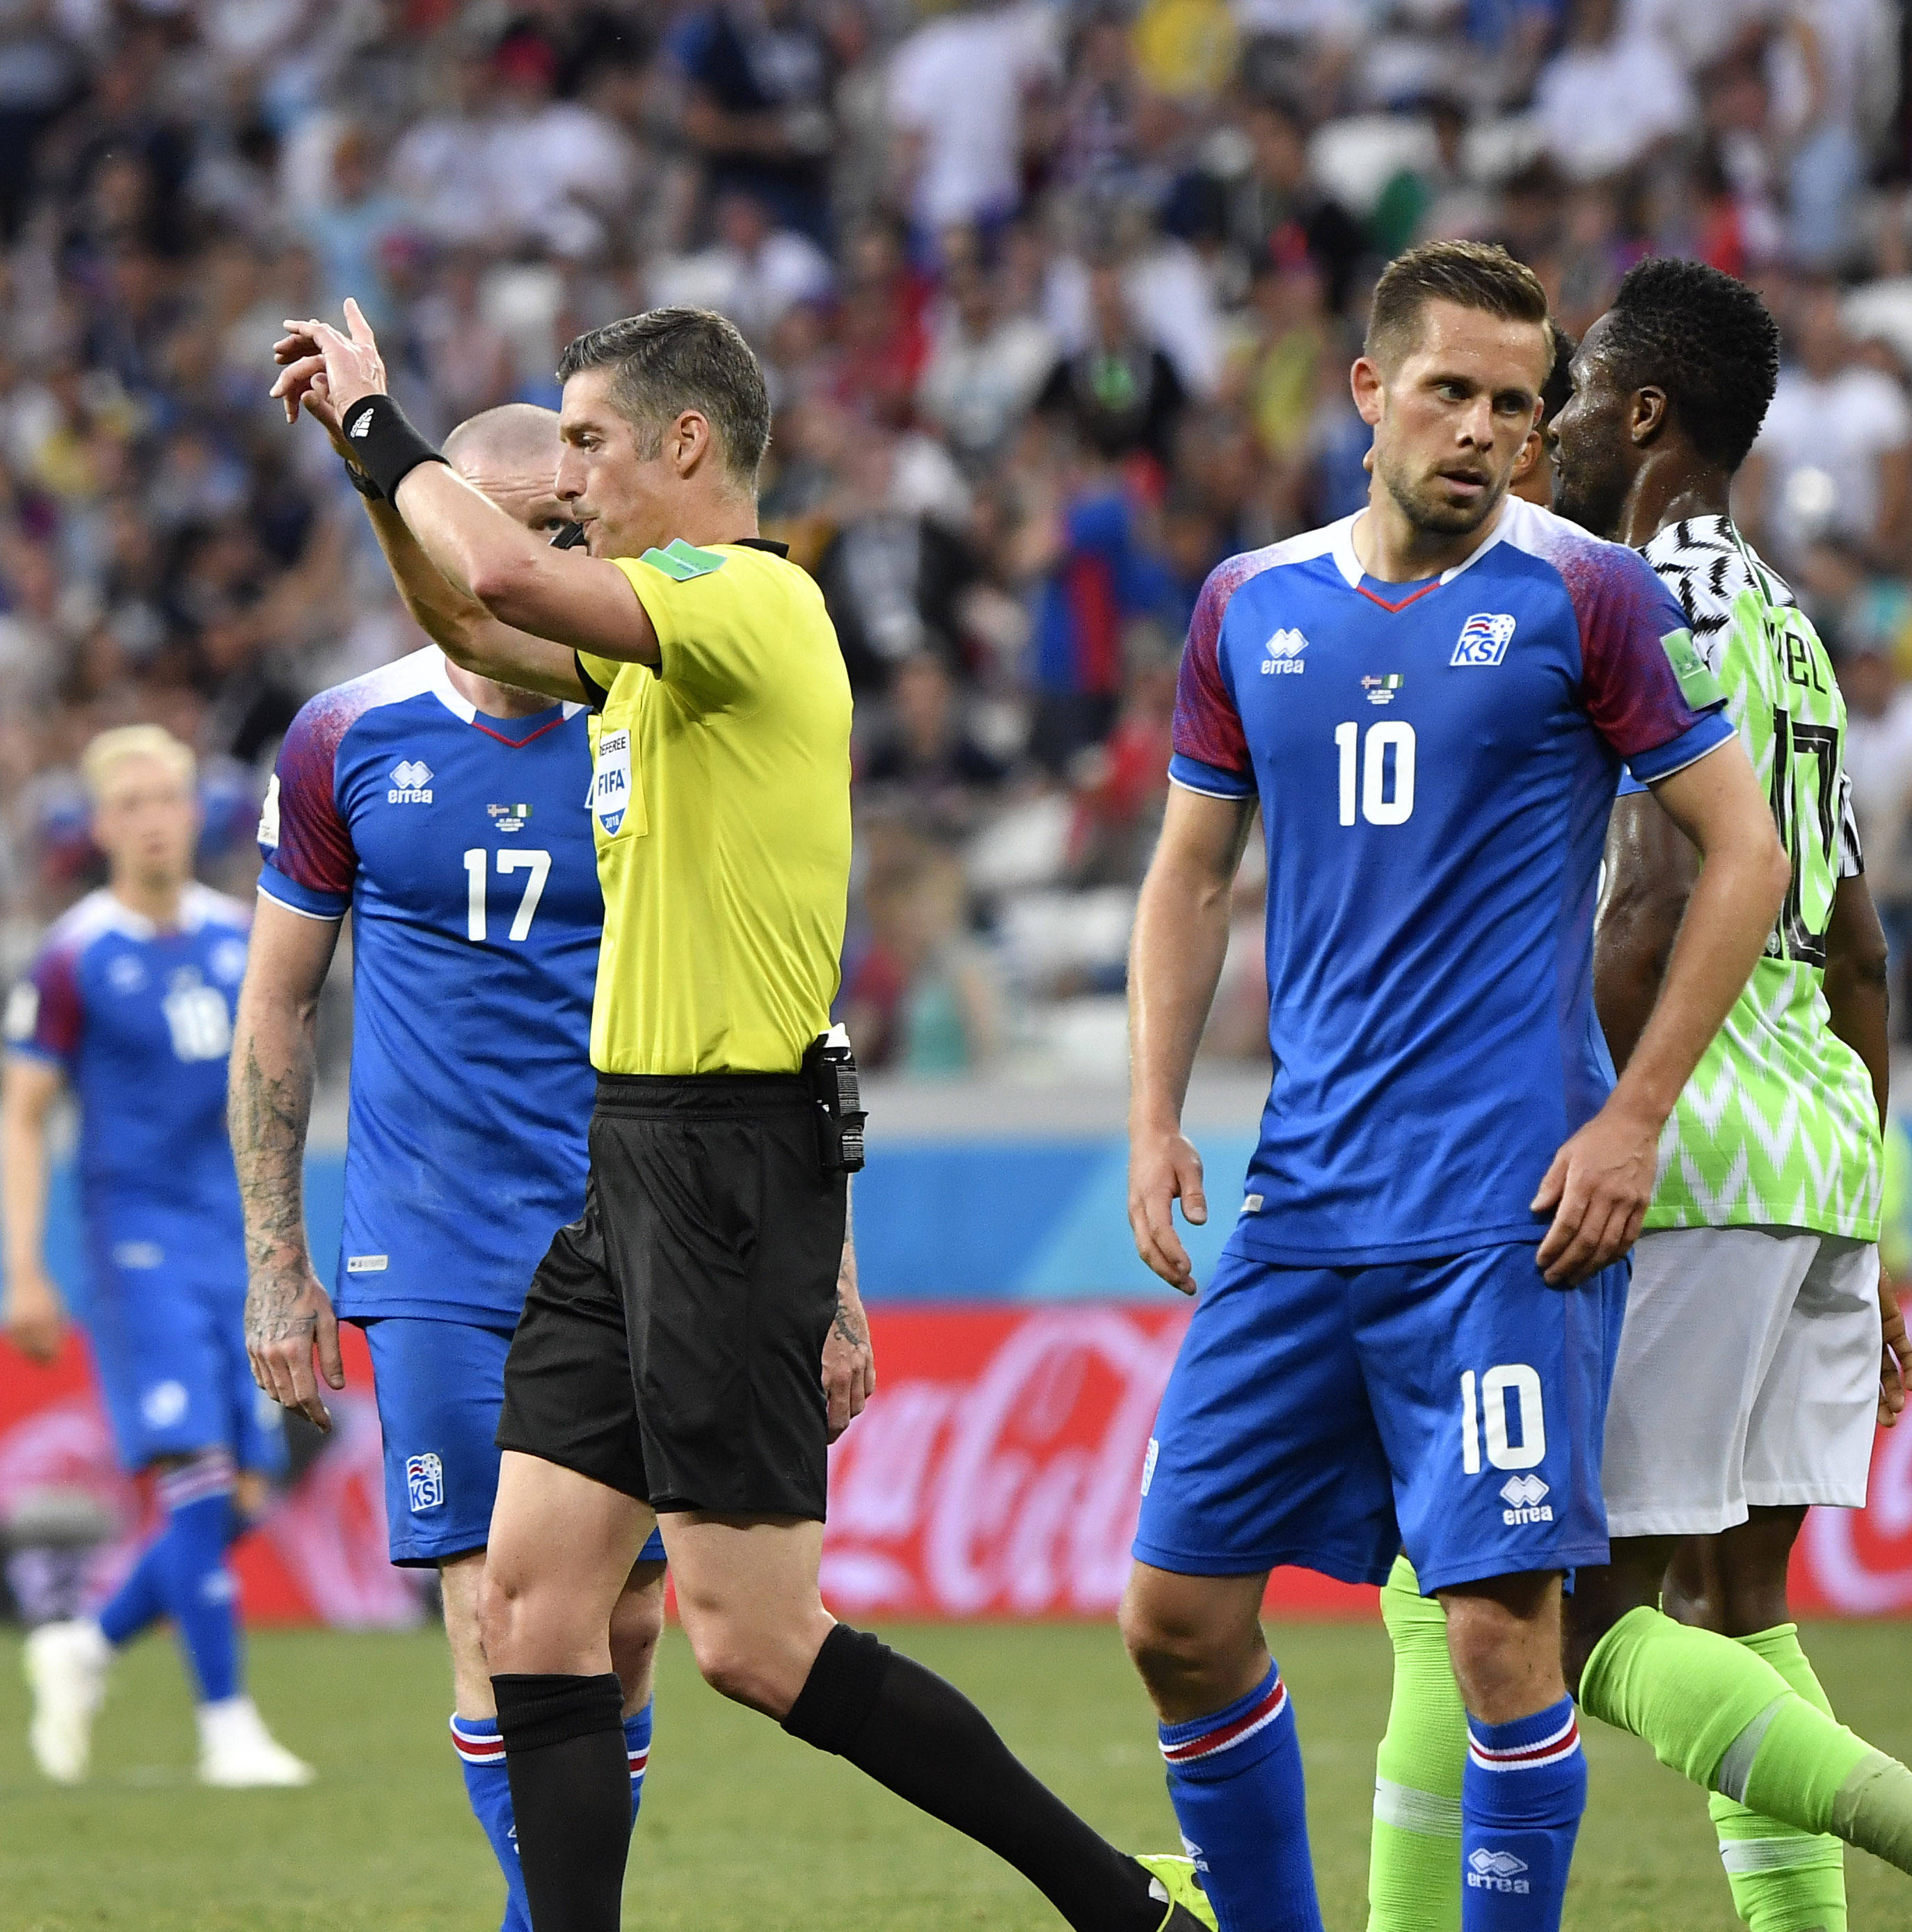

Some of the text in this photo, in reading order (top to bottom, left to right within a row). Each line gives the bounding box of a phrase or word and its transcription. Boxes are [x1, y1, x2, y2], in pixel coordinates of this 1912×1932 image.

[1455, 640, 1506, 662] KSI
[1260, 659, 1305, 674] errea
[598, 768, 626, 797] FIFA
[1335, 720, 1417, 827] 10
[388, 788, 433, 804] errea
[605, 814, 619, 829] 2018
[463, 848, 552, 941] 17
[1460, 1364, 1546, 1474] 10
[411, 1478, 441, 1509] KSI
[1502, 1505, 1553, 1526] errea
[1467, 1871, 1530, 1894] errea
